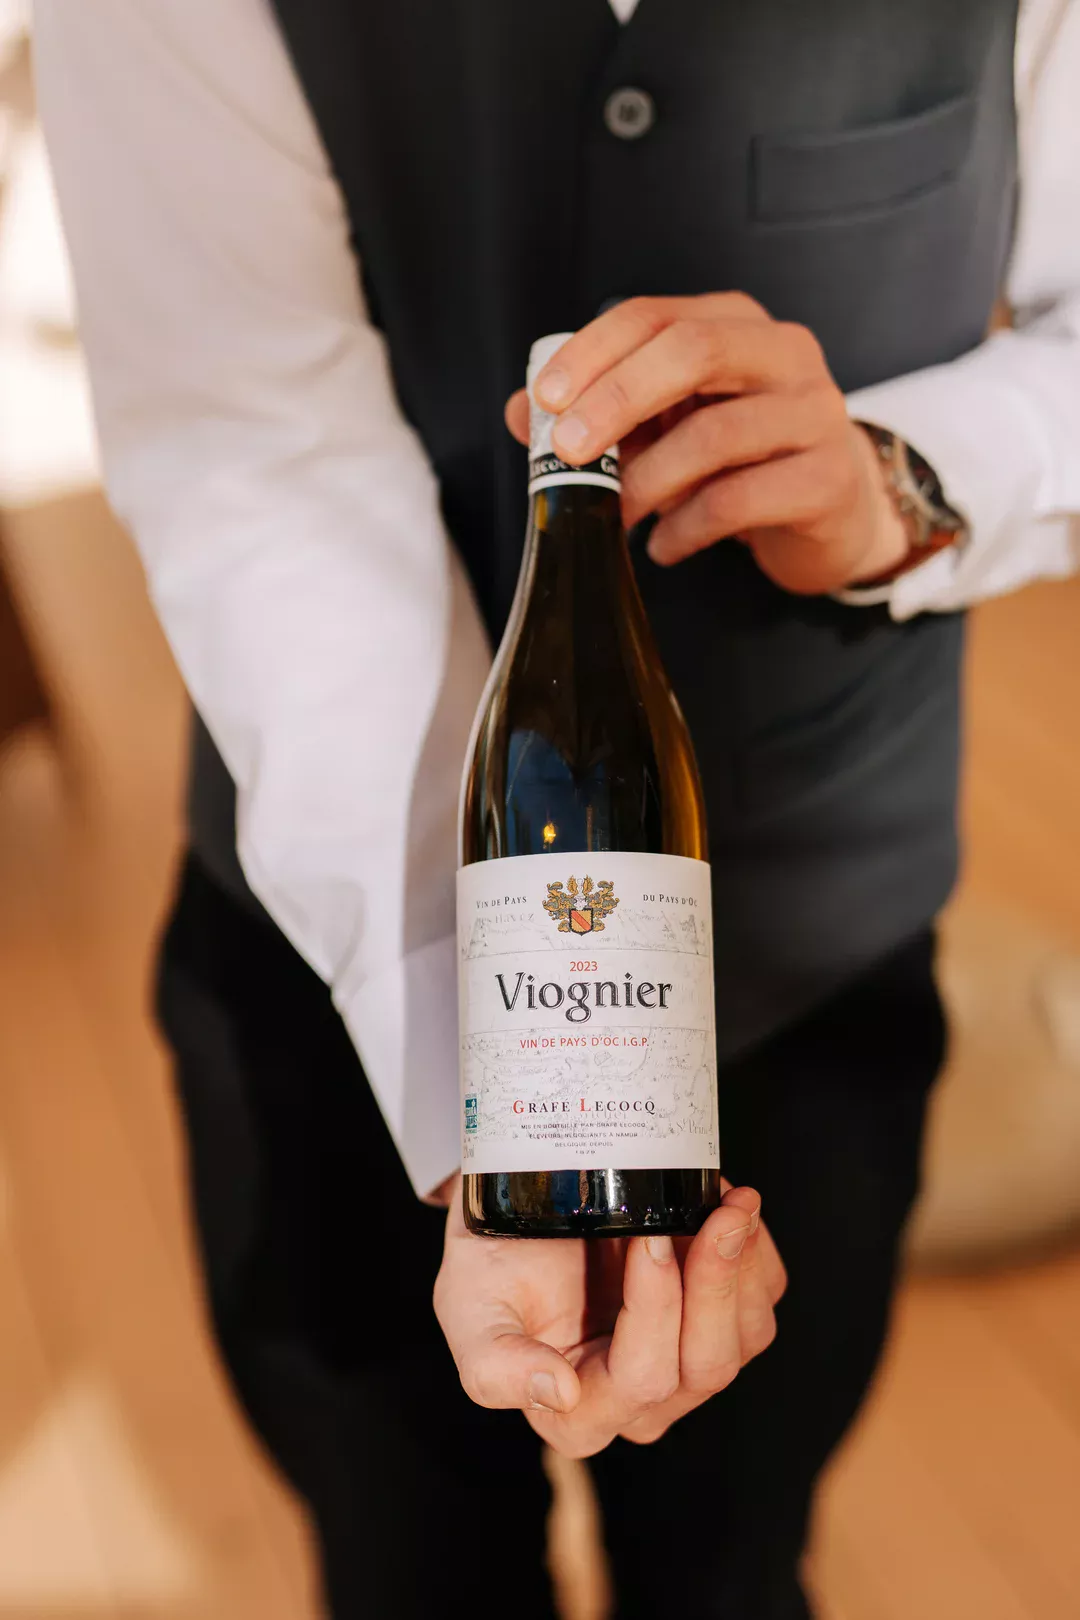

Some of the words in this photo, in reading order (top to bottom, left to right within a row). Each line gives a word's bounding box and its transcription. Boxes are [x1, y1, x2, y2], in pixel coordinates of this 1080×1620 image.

[569, 961, 598, 972] 2023
[495, 972, 673, 1024] Viognier
[520, 1039, 538, 1049] VIN
[542, 1038, 556, 1048] DE
[560, 1037, 587, 1047] PAYS
[591, 1036, 620, 1047] D'OC
[623, 1036, 650, 1047] I.G.P.
[580, 1098, 656, 1115] LECOCQ
